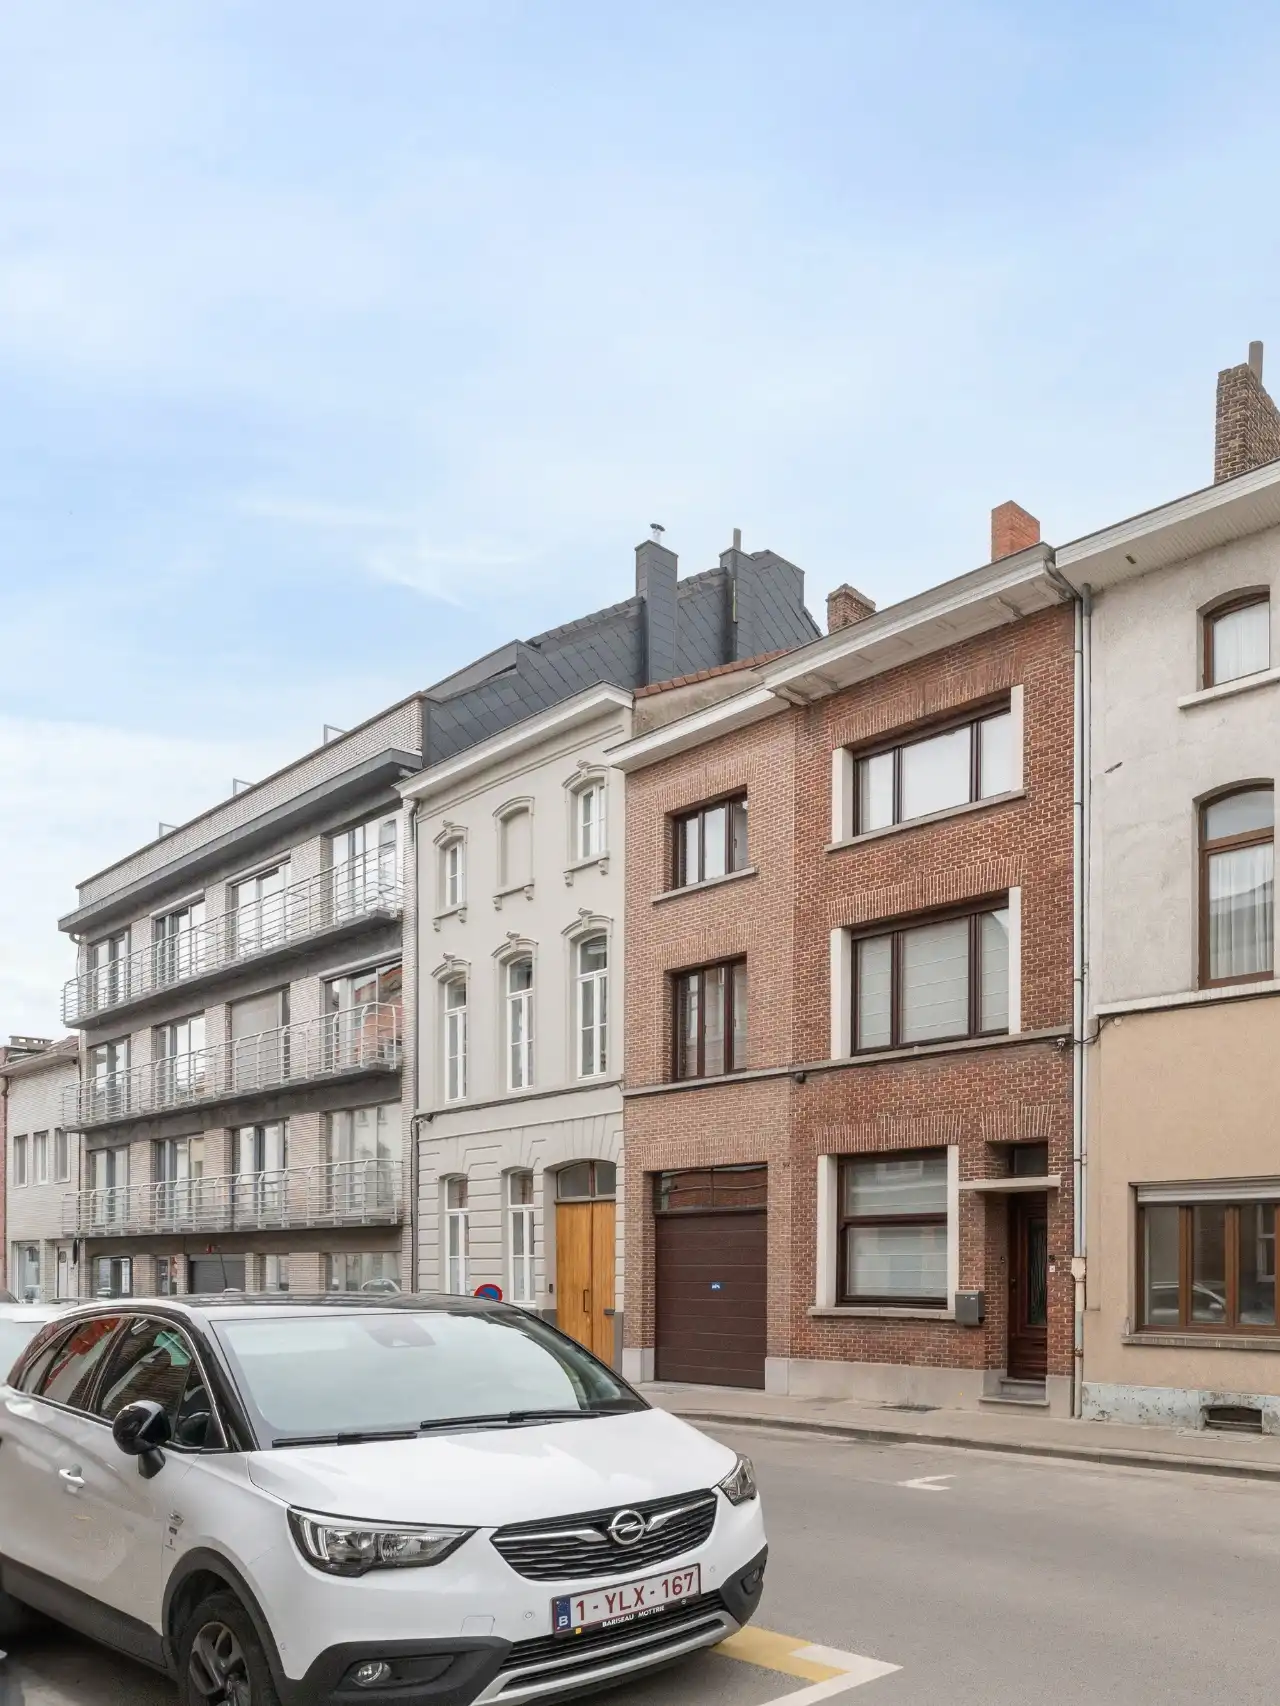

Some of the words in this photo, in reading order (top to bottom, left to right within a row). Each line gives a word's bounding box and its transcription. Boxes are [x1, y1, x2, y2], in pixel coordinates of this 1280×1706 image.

[558, 1615, 569, 1627] B
[602, 1613, 634, 1628] BARISEAU
[638, 1604, 665, 1618] MOTTRIE
